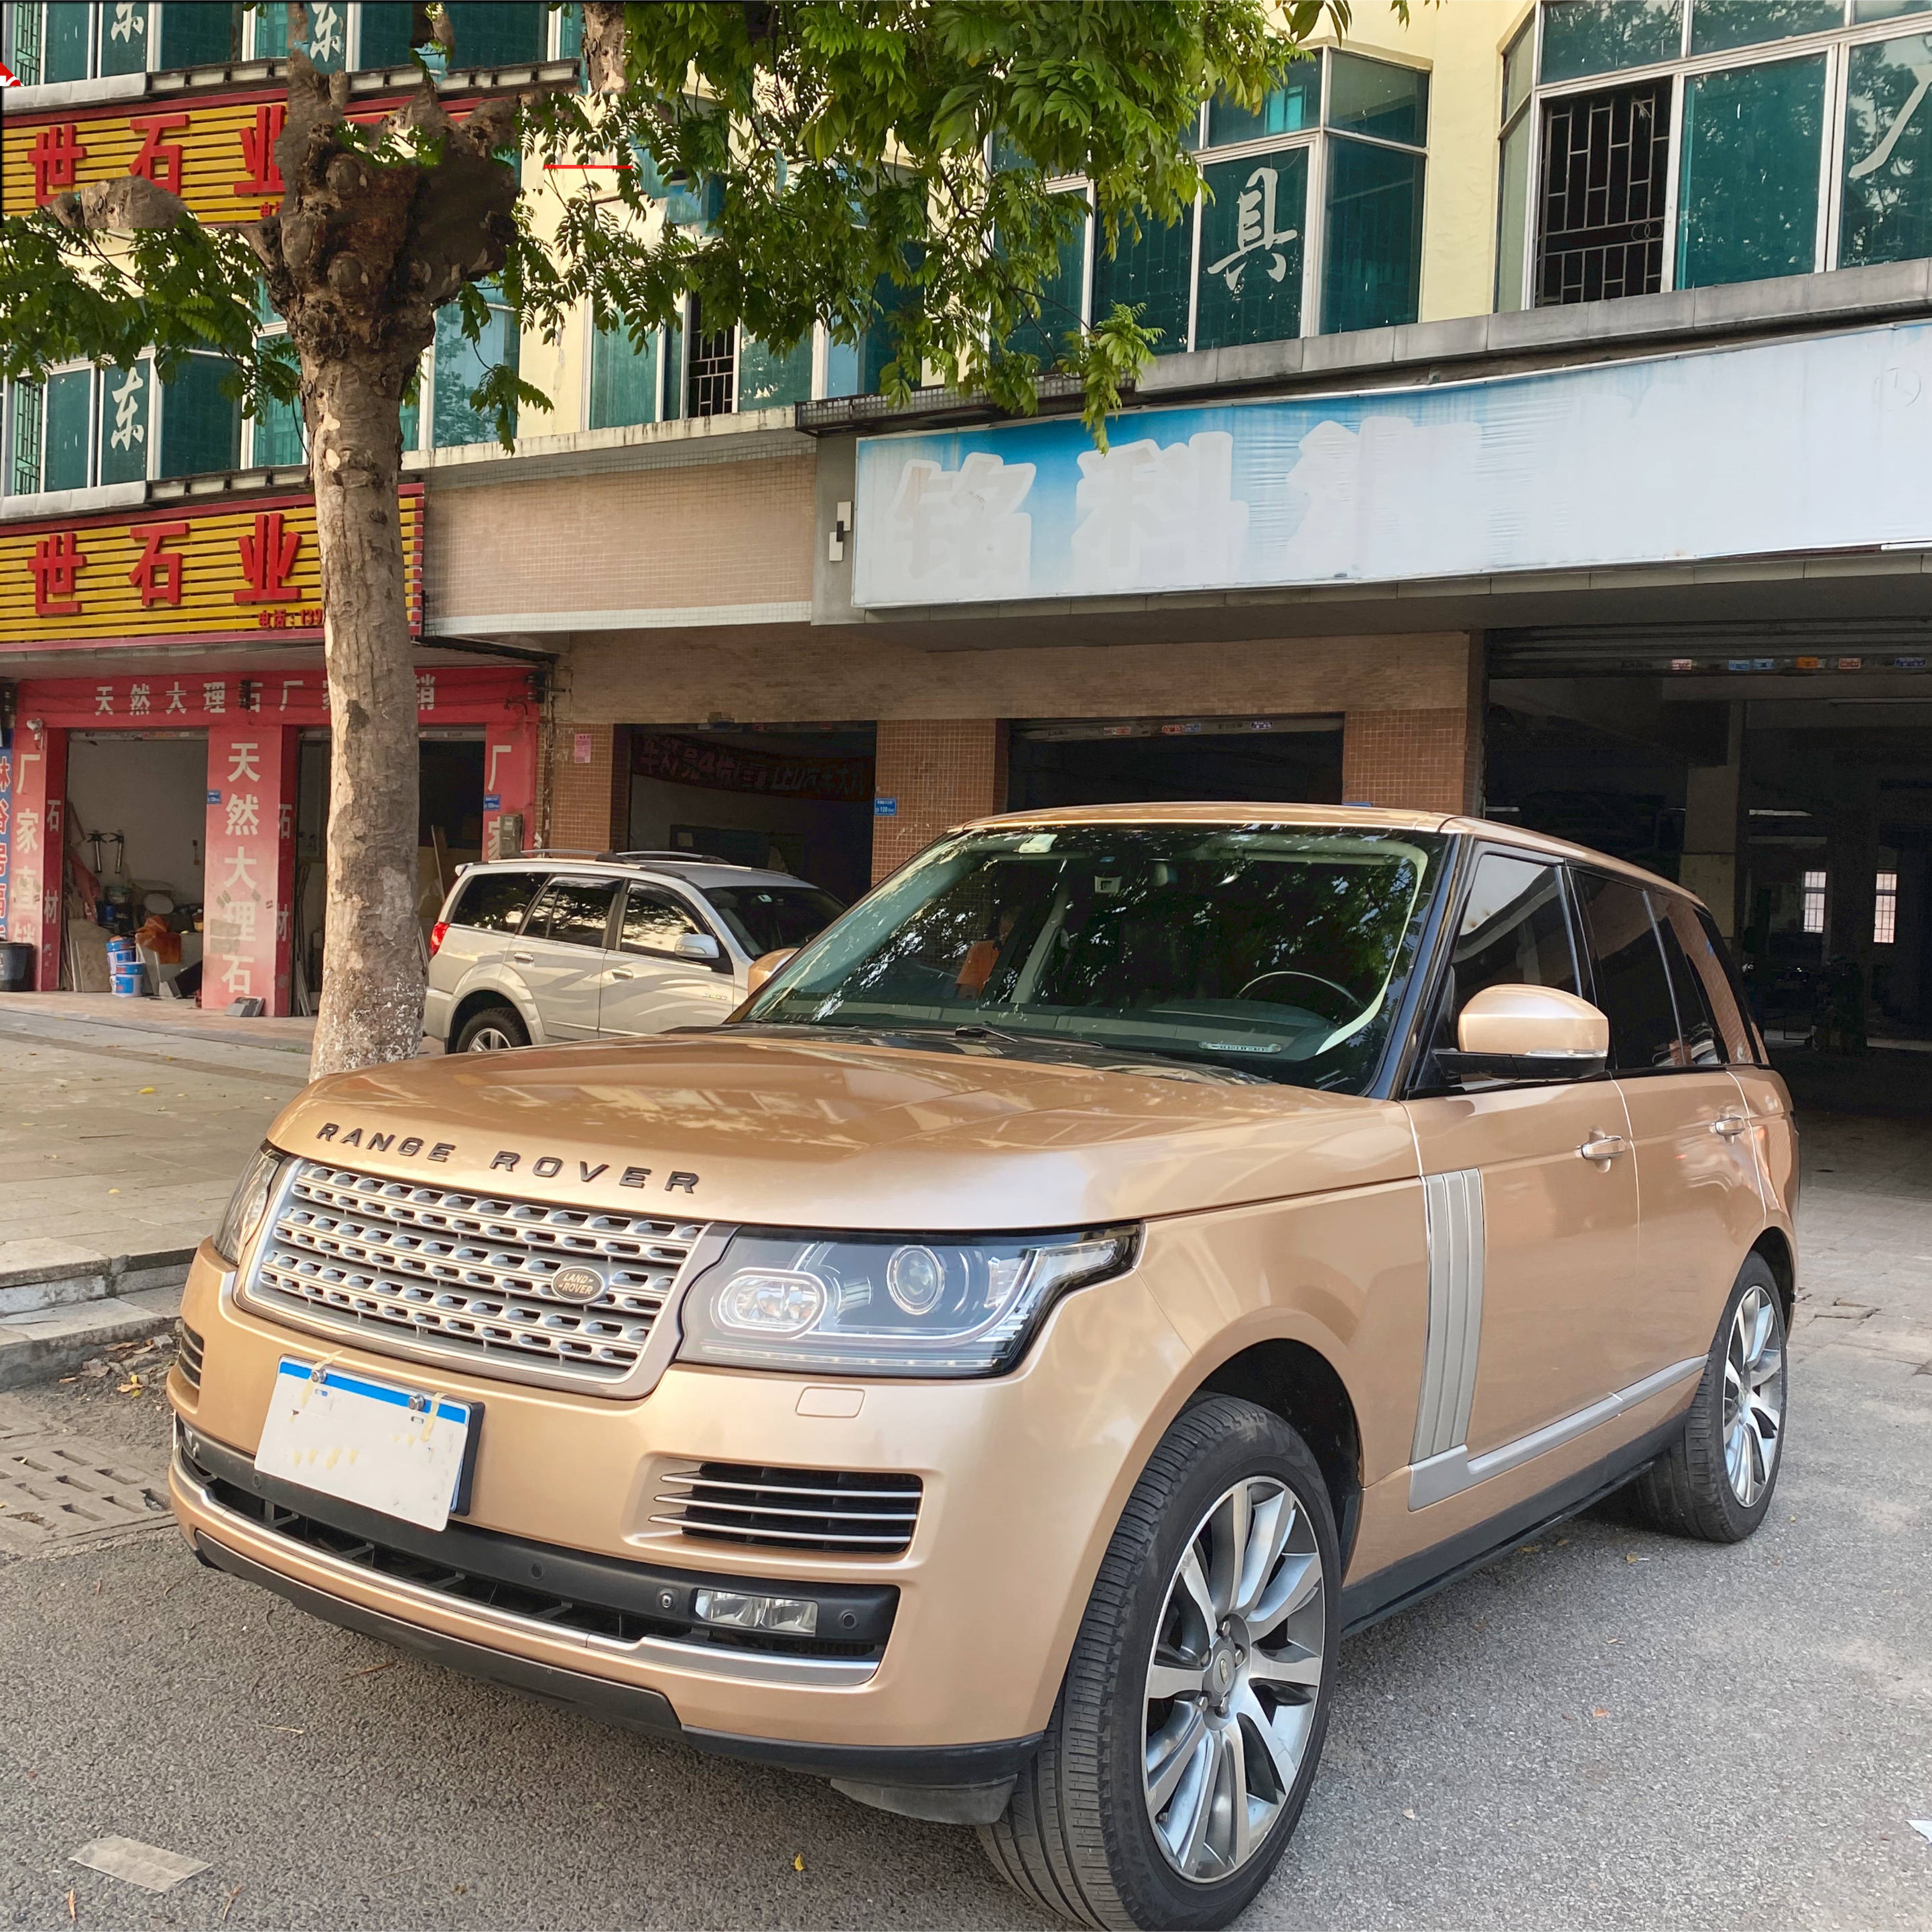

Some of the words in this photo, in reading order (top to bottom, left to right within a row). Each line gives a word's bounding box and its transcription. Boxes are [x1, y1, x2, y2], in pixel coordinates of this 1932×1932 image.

[27, 513, 301, 617] 世石业
[221, 743, 261, 994] 天然大理石
[316, 1122, 456, 1163] RANGE
[489, 1150, 700, 1194] ROVER
[562, 1282, 594, 1295] ROVER
[563, 1273, 589, 1283] LAND
